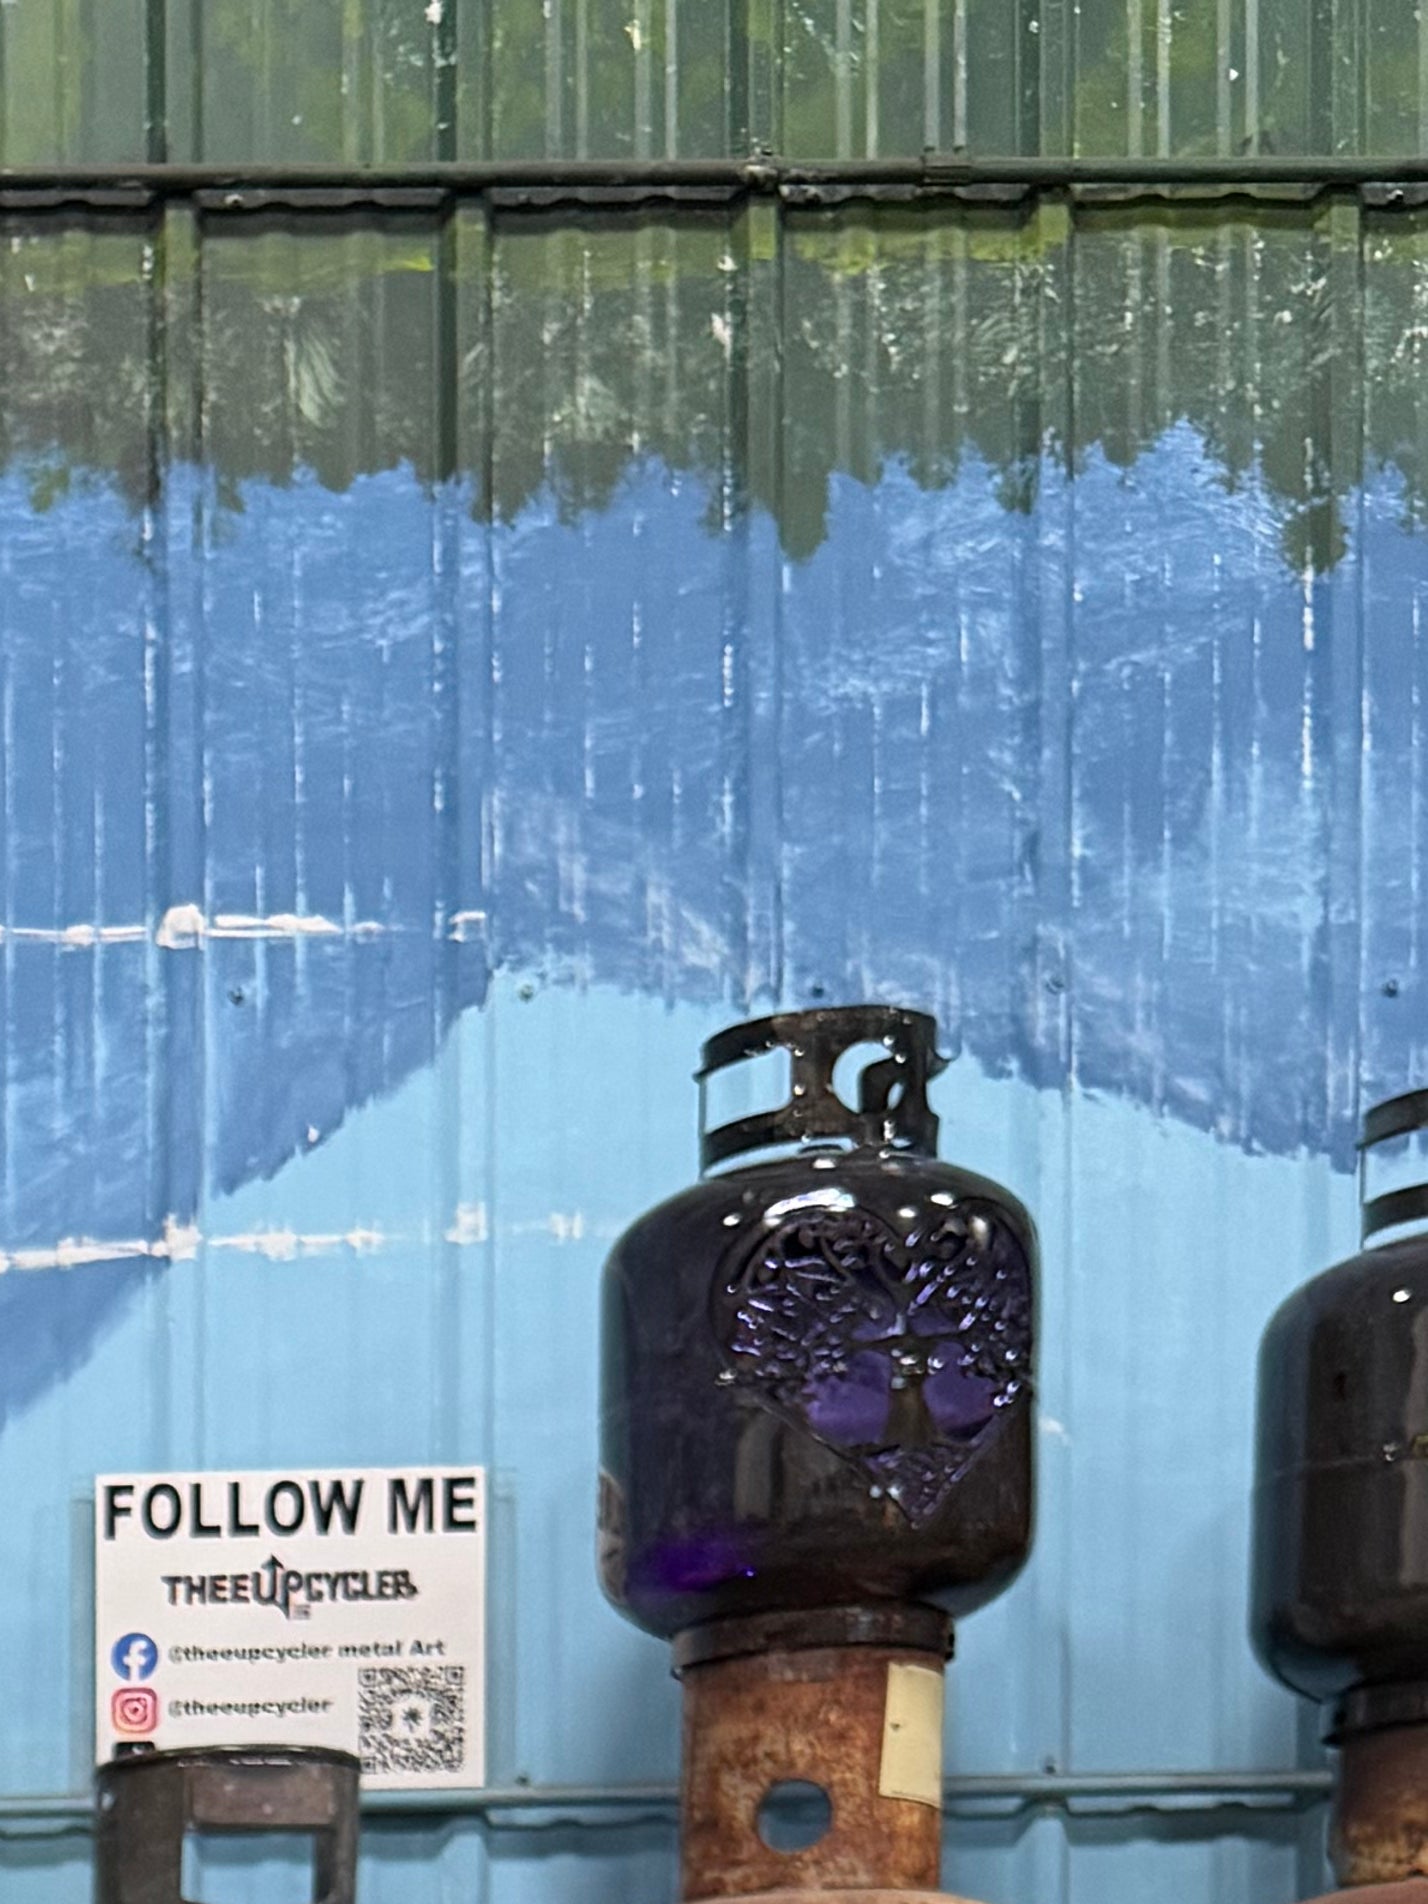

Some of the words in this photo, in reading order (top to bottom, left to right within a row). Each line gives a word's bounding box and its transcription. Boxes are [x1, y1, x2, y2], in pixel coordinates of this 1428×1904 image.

[103, 1478, 365, 1541] FOLLOW
[387, 1476, 478, 1535] ME
[338, 1640, 401, 1658] metal
[408, 1639, 446, 1657] Art
